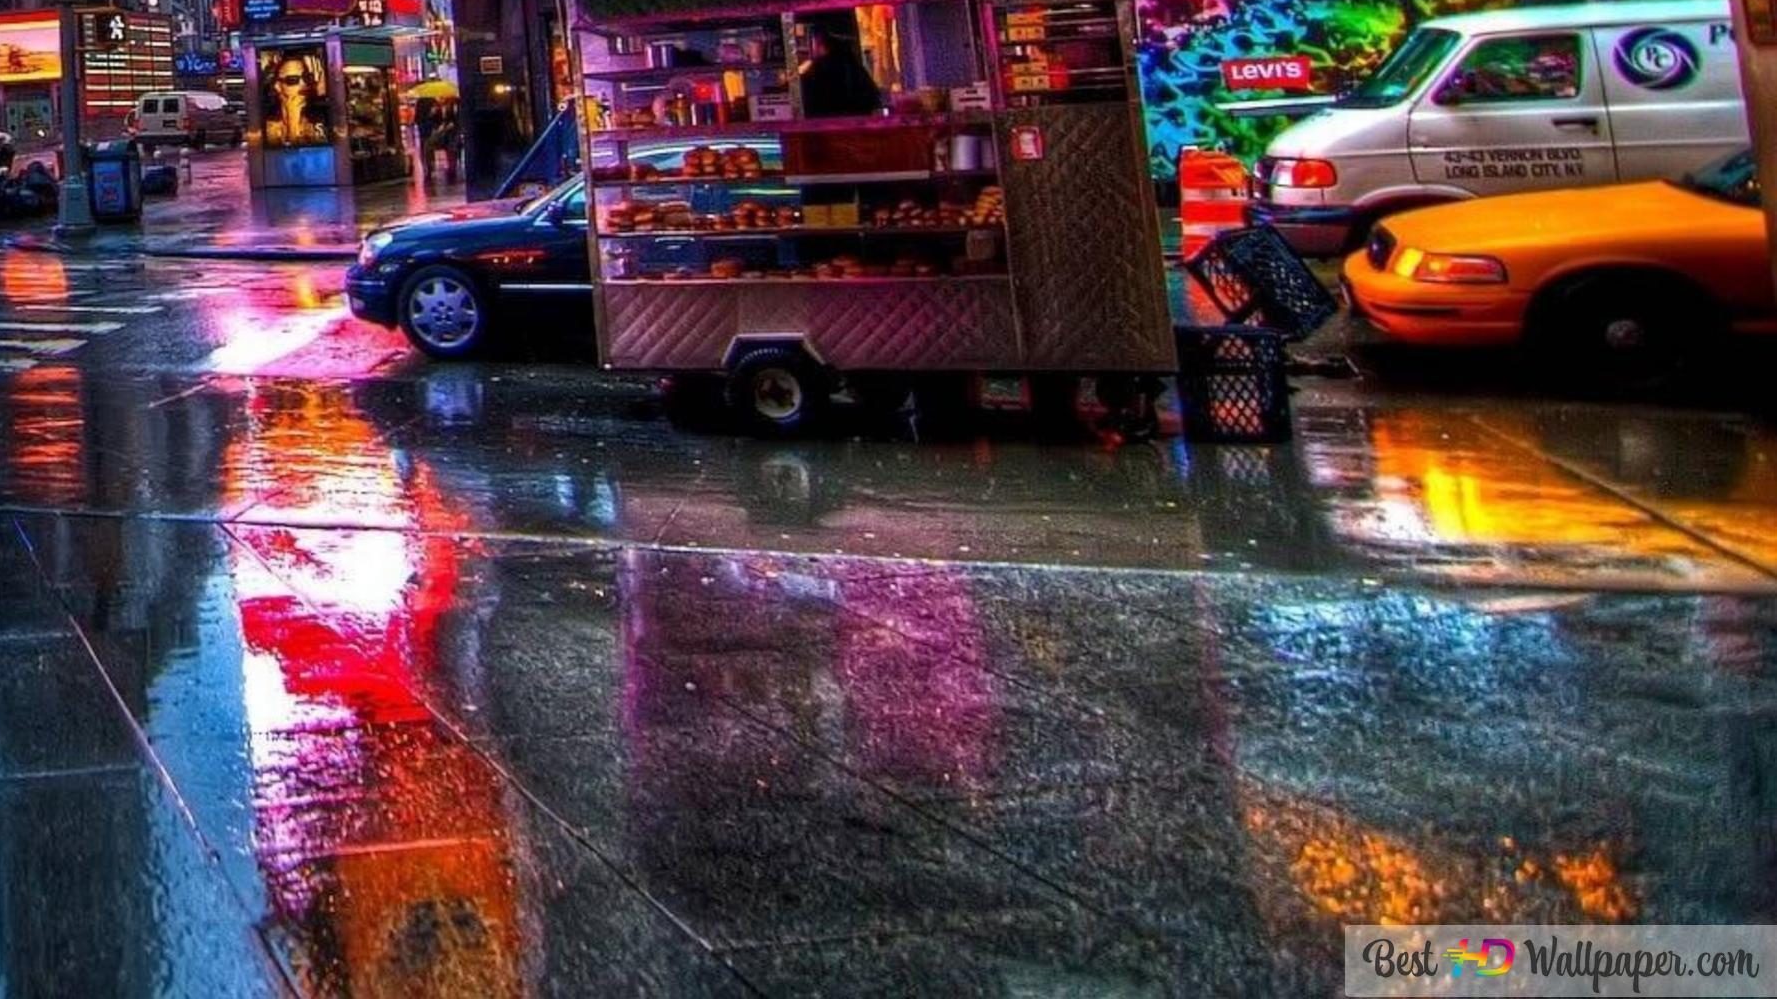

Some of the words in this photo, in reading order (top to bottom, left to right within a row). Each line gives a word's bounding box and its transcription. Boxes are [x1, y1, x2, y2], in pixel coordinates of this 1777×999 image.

[1486, 149, 1543, 162] VERNON
[1445, 164, 1481, 180] LONG
[1482, 164, 1528, 178] ISLAND
